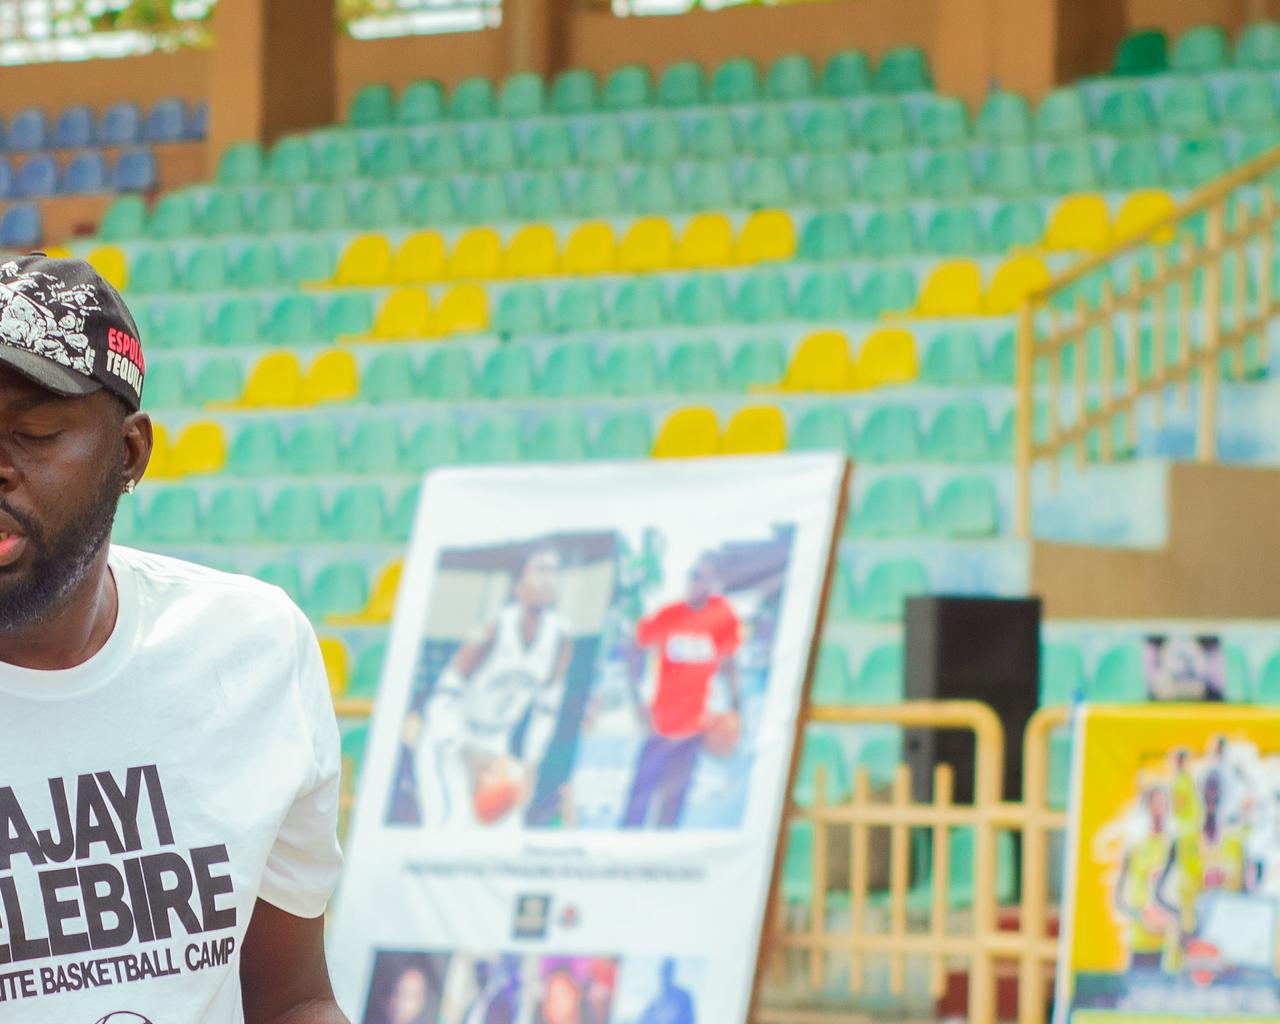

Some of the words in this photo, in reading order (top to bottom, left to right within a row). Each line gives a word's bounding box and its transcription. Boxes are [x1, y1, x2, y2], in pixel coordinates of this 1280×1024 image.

[108, 327, 145, 375] ESPOL
[42, 948, 180, 994] BASKETBALL
[185, 937, 235, 973] CAMP
